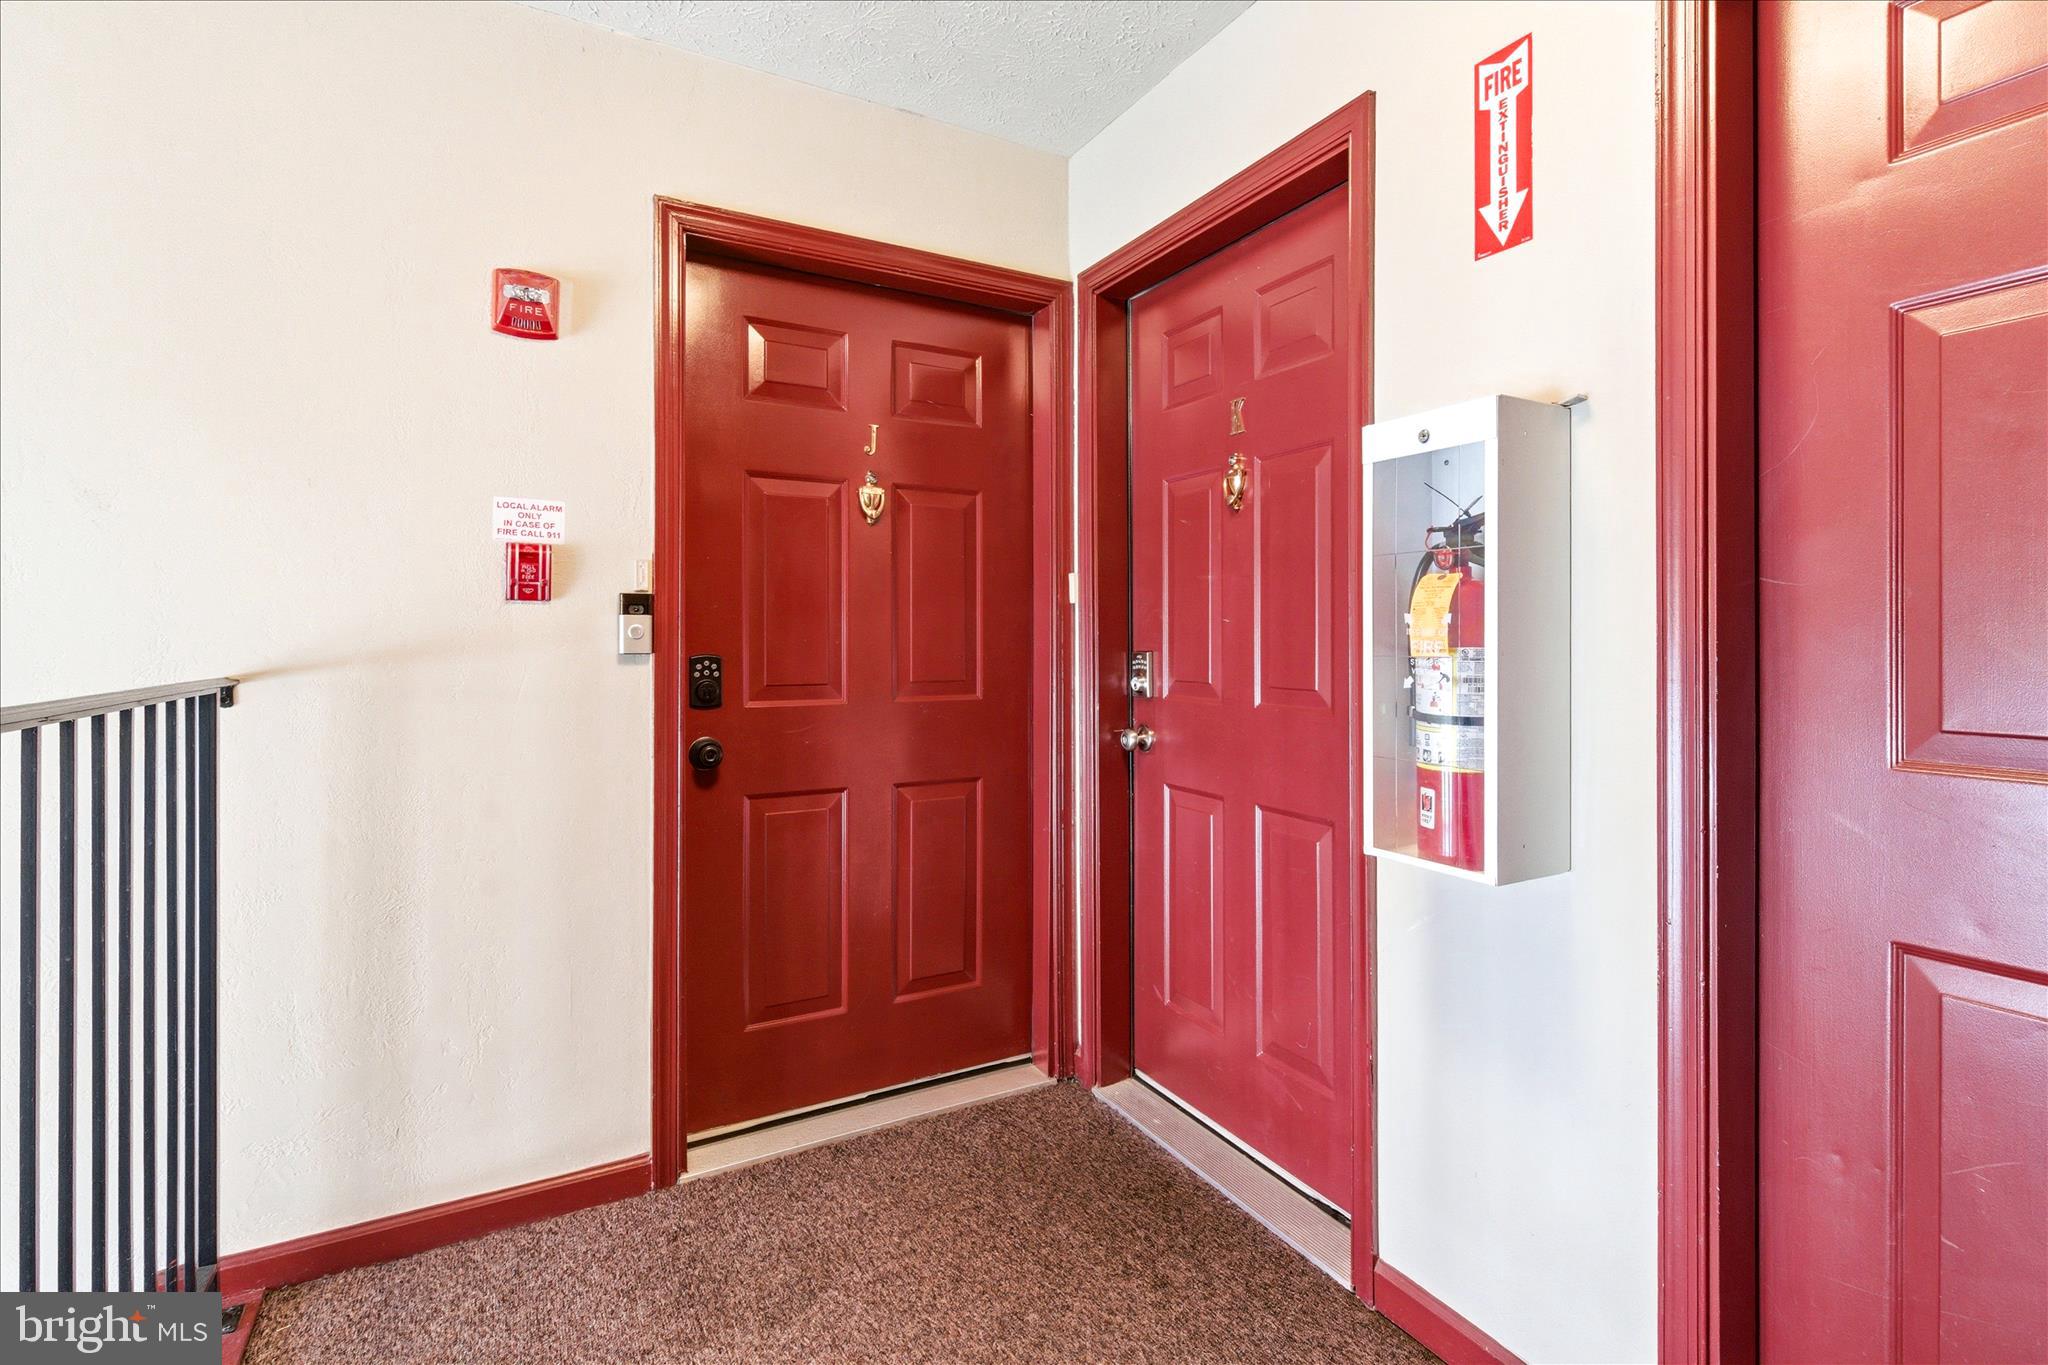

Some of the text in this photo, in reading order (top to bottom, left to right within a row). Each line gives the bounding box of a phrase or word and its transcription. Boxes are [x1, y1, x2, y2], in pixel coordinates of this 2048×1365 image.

[1484, 57, 1523, 103] FIRE
[1498, 98, 1509, 232] EXTINGUISHER
[509, 303, 543, 317] FIRE
[863, 423, 880, 456] J
[496, 501, 563, 513] LOCAL ALARM
[517, 511, 542, 520] ONLY
[515, 520, 541, 529] CASE
[543, 522, 556, 530] OF
[496, 528, 561, 539] FIRE CALL 911
